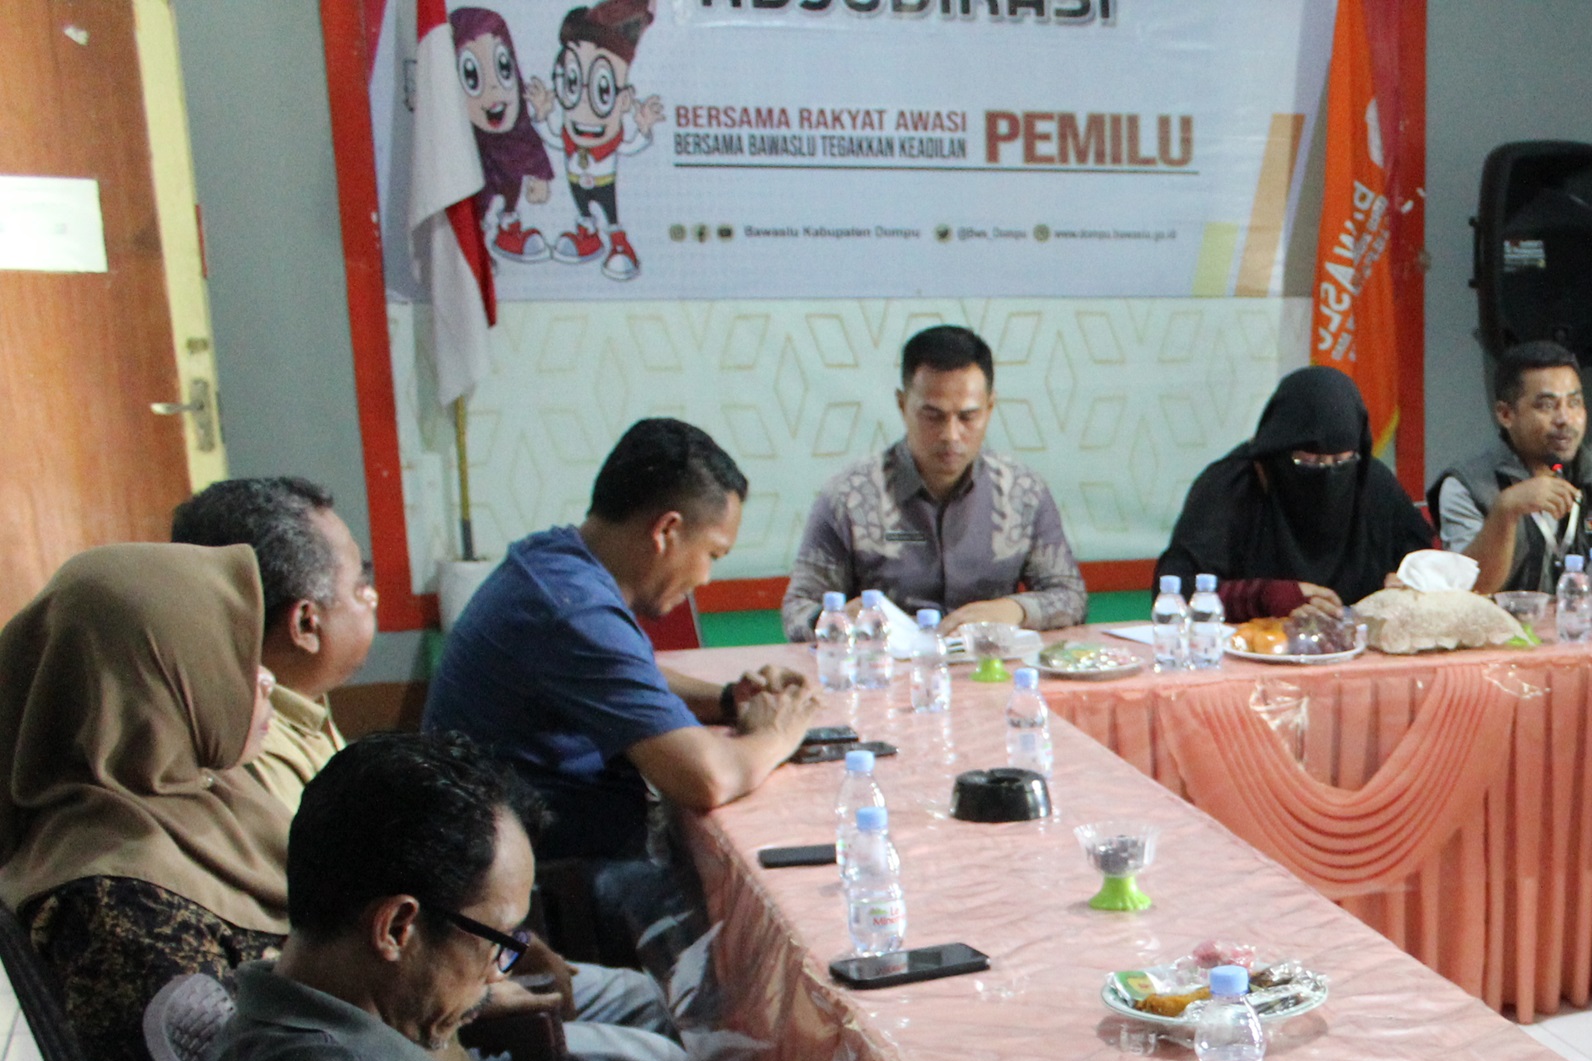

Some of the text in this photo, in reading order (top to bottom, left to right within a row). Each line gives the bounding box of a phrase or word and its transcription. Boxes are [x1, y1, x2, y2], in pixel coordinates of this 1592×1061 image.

[675, 106, 967, 132] BERSAMA RAKYAT AWASI
[674, 132, 966, 159] BERSAMA BAWASLU TEGAKKAN KEADILAN
[985, 110, 1193, 166] PEMILU
[744, 225, 920, 240] Bawaslu Kabupaten Dompu
